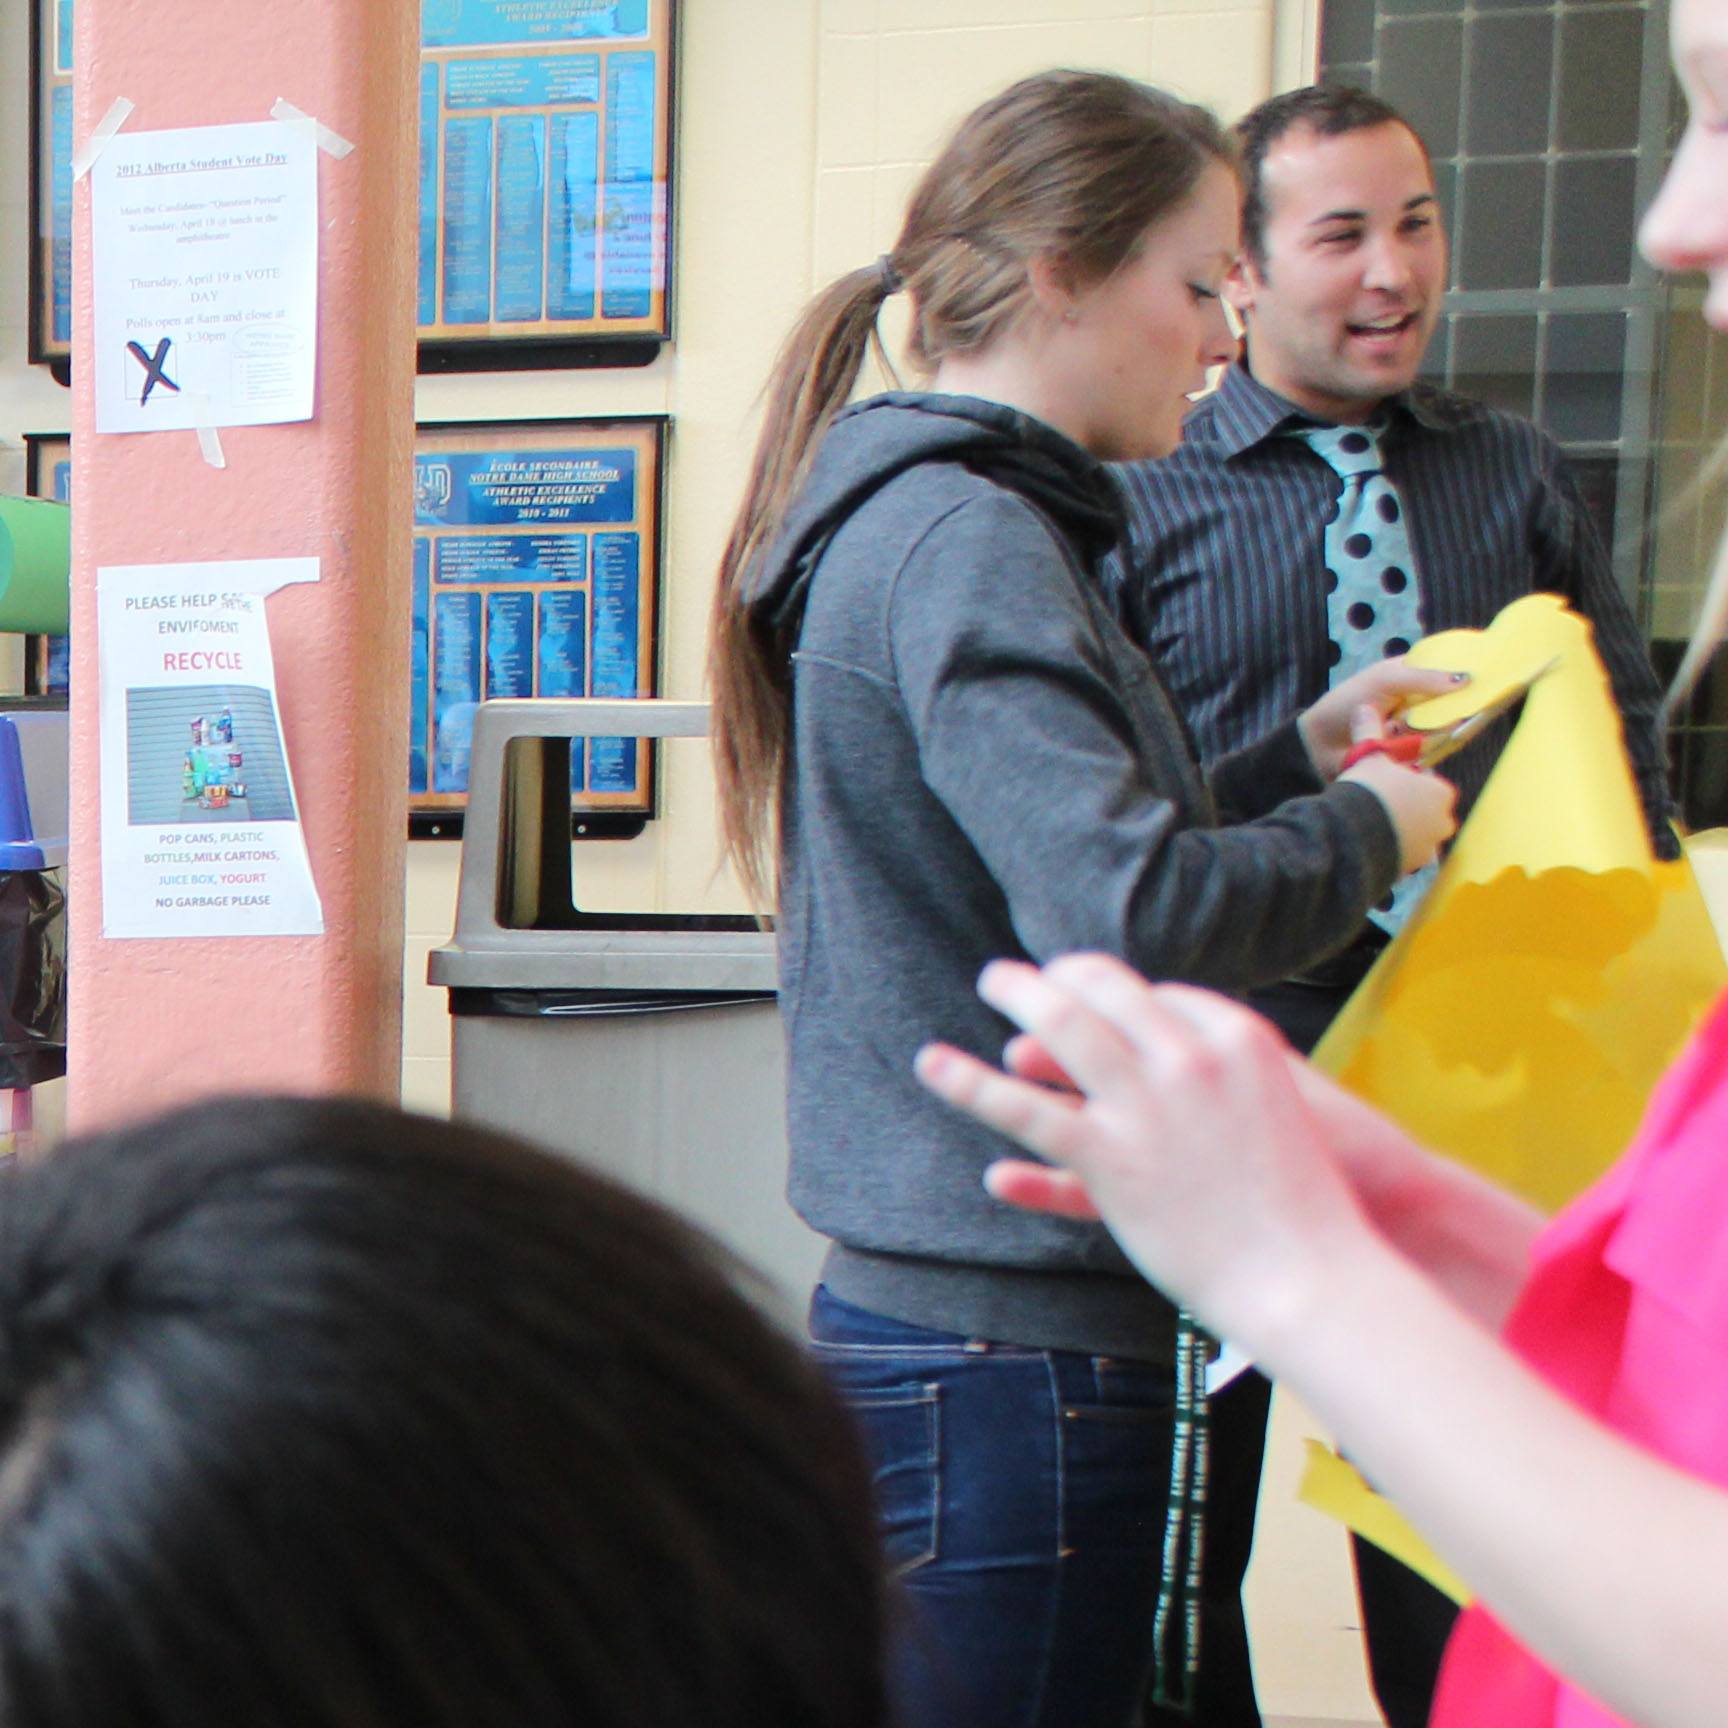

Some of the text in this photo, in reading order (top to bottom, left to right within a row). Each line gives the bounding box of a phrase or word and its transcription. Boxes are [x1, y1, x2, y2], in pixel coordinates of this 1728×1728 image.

[117, 152, 288, 177] 2012 Alberta Student Vote Day
[130, 277, 182, 289] Thursday,
[186, 274, 213, 285] April
[218, 272, 230, 283] 19
[245, 267, 280, 280] VOTE
[190, 290, 218, 303] DAY
[126, 318, 153, 329] Polls
[155, 318, 180, 328] open
[223, 311, 242, 322] and
[245, 310, 272, 321] close
[469, 473, 506, 483] NOTRE
[509, 472, 541, 482] DAME
[543, 471, 573, 481] HIGH
[482, 484, 607, 496] ATHLETIC EXCELLENCE
[493, 494, 595, 506] AWARD RECIPIENTS
[125, 595, 177, 610] PLEASE
[182, 593, 217, 607] HELP
[164, 651, 243, 671] RECYCLE
[159, 832, 264, 844] POP CANS, PLASTIC
[224, 850, 280, 861] CARTONS,
[159, 873, 266, 885] JUICE BOX, YOGURT
[155, 895, 271, 908] NO GARBAGE PLEASE
